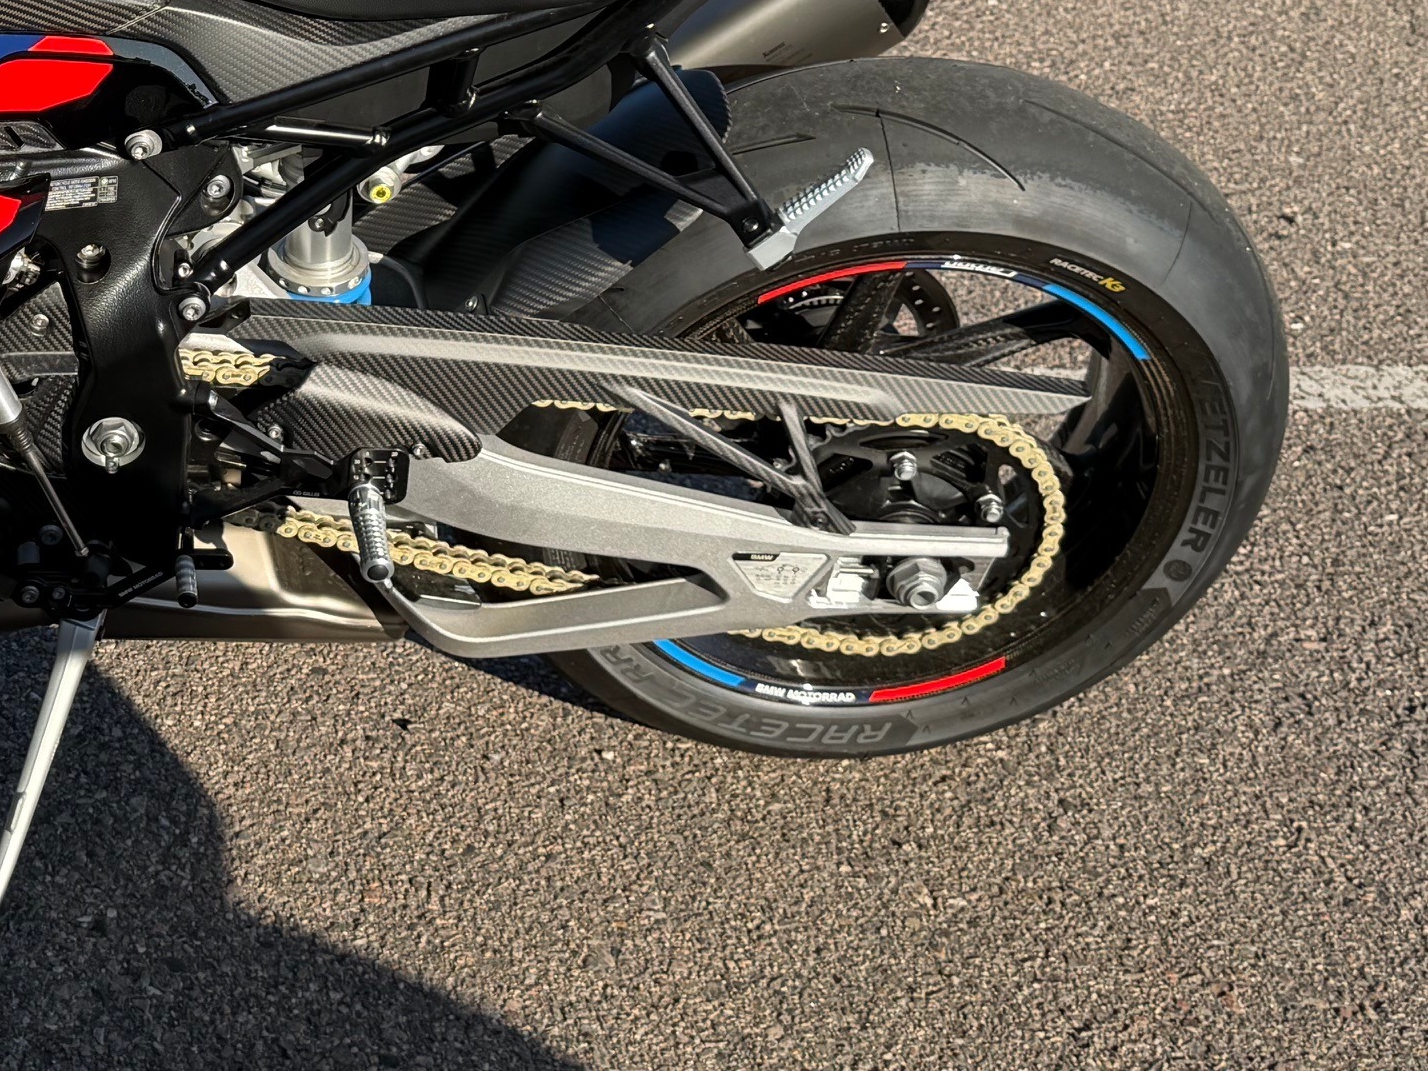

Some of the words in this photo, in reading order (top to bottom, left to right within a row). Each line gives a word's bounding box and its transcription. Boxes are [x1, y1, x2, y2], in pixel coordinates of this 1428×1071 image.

[1049, 258, 1104, 282] RACETEC
[1098, 277, 1126, 292] K3
[755, 682, 786, 698] BMW
[786, 689, 856, 704] MOTORRAD
[662, 680, 893, 745] RACETEC
